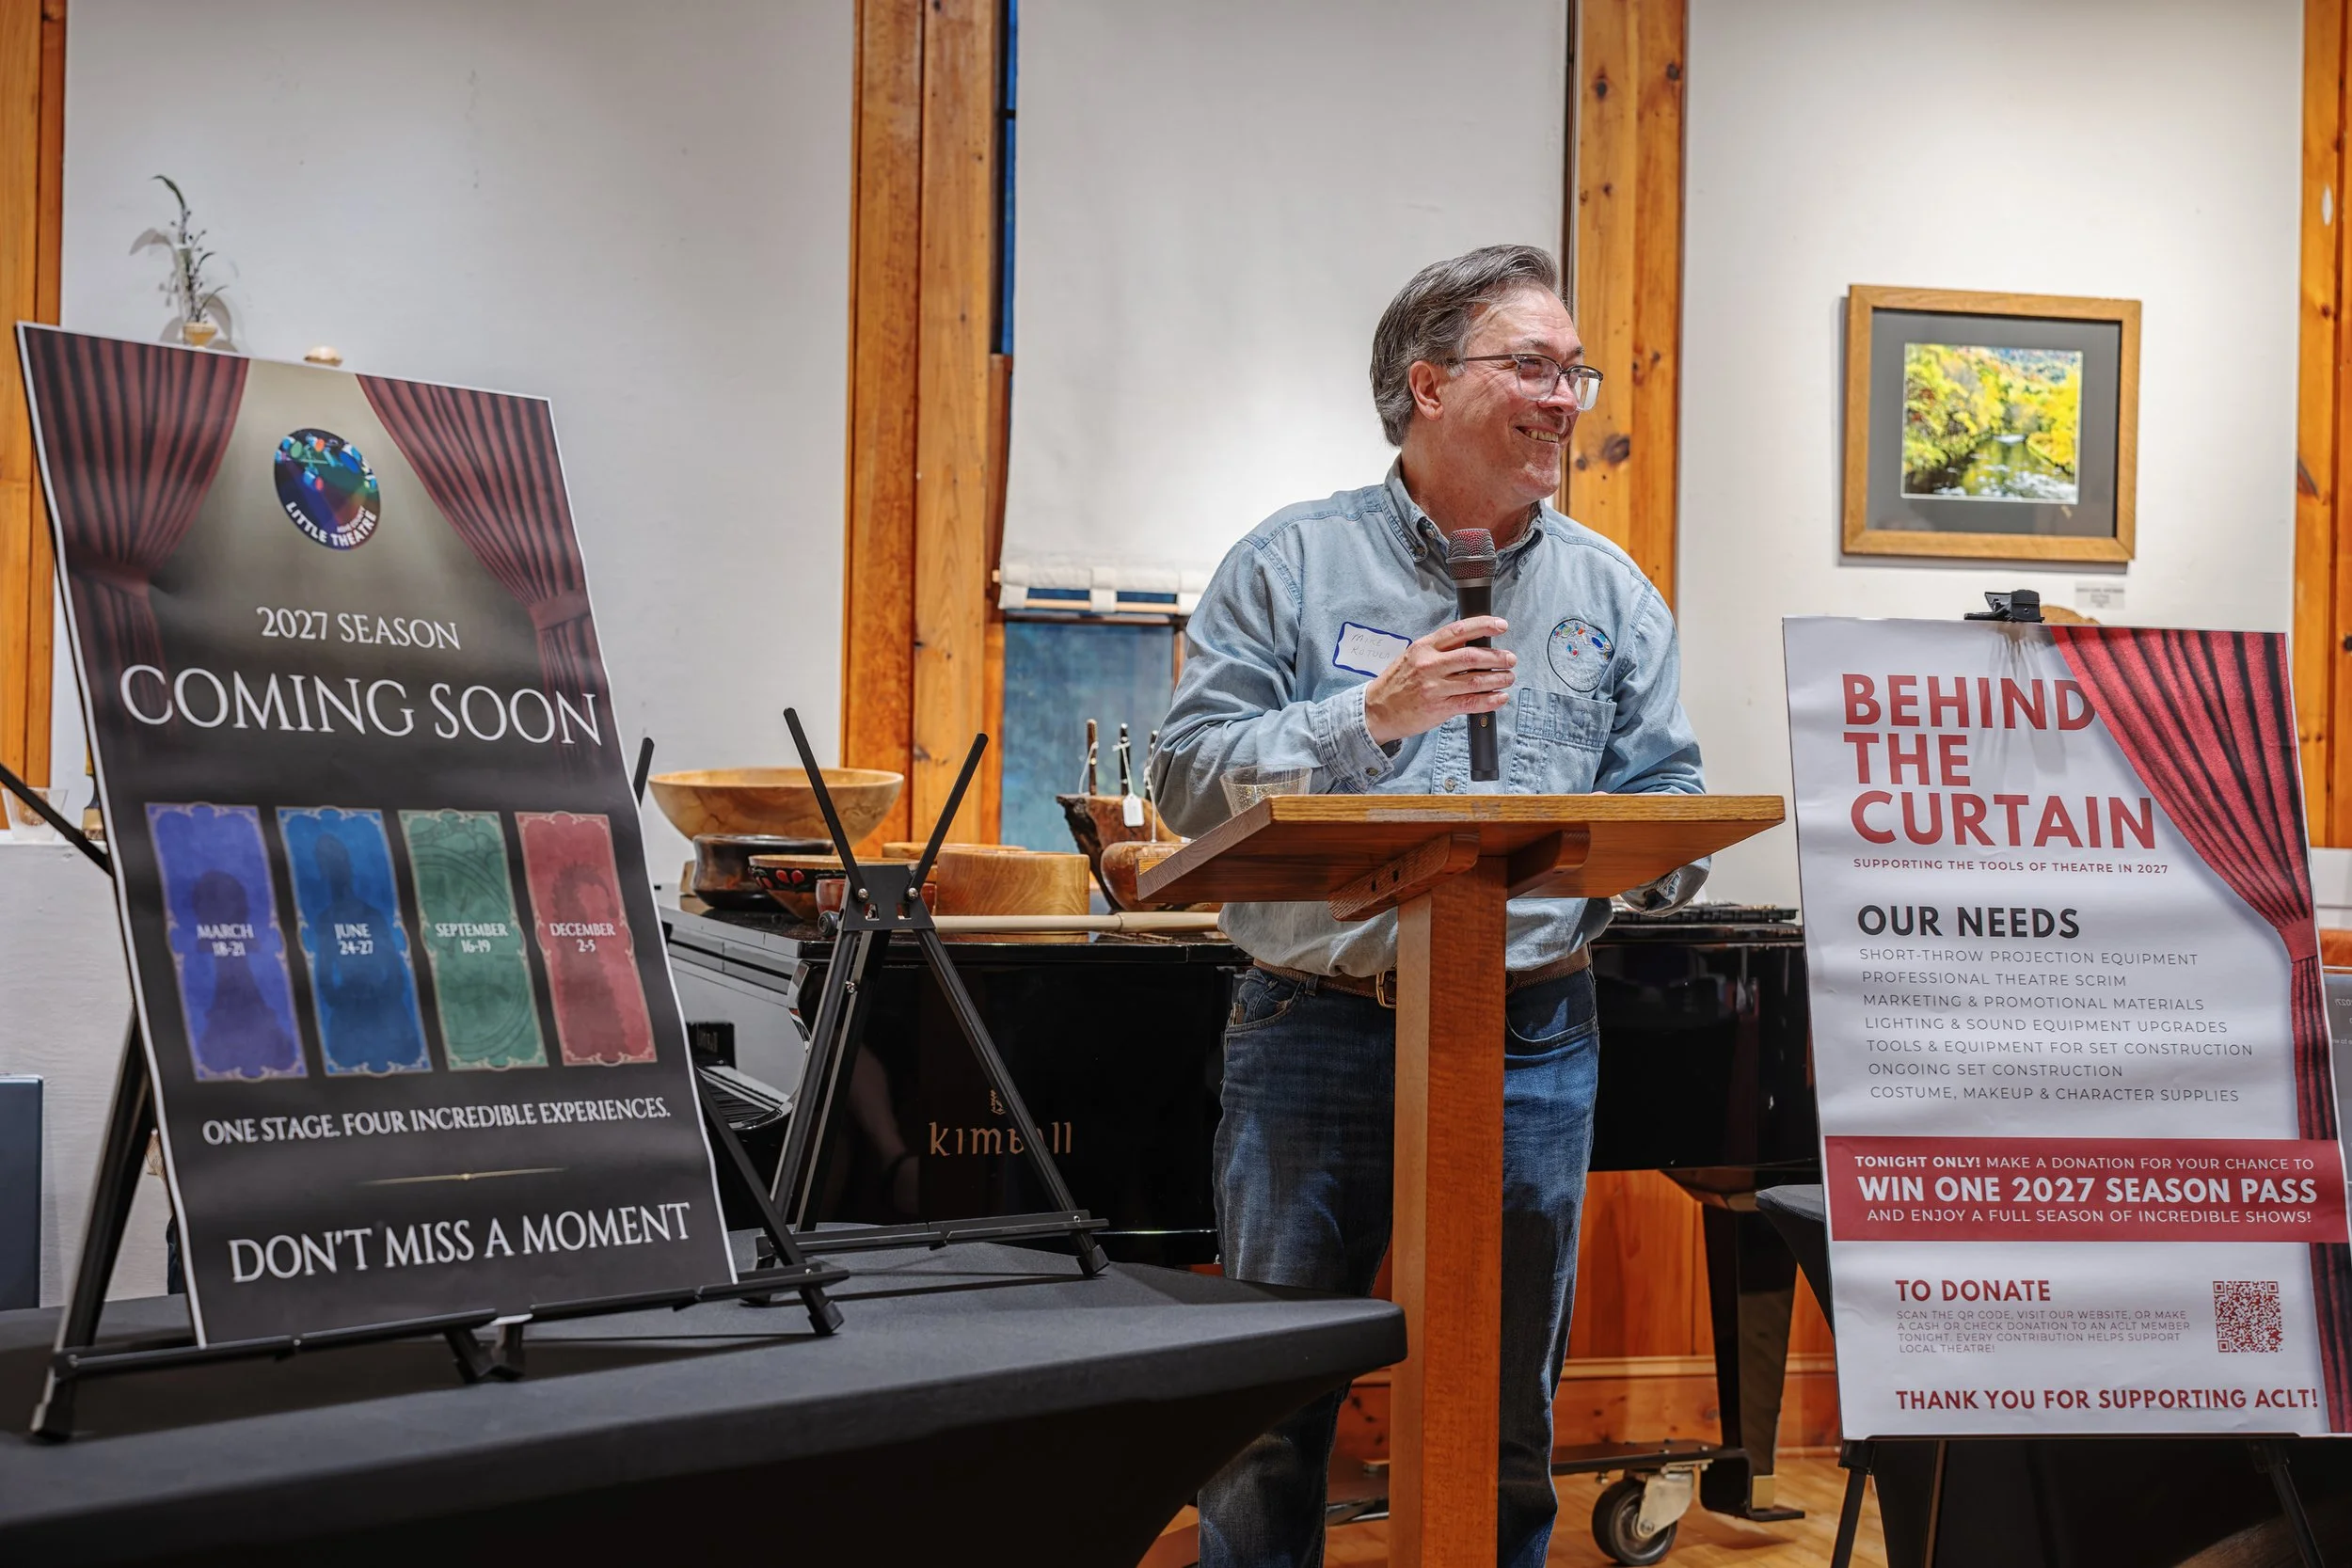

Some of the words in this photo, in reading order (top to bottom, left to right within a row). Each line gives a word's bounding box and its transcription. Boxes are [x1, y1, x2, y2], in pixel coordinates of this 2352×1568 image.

[286, 501, 327, 543] LITTLE
[330, 510, 376, 546] THEATRE
[256, 606, 328, 641] 2027
[337, 612, 461, 650] SEASON
[119, 664, 415, 736] COMING
[429, 683, 602, 746] SOON
[1842, 673, 2095, 730] BEHIND
[1844, 732, 1971, 787] THE
[1851, 791, 2156, 849] CURTAIN
[1853, 858, 1943, 870] SUPPORTING
[1947, 860, 1975, 870] THE
[1979, 861, 2025, 871] TOOLS
[2028, 862, 2047, 872] OF
[2051, 863, 2114, 873] THEATRE
[2118, 863, 2133, 873] IN
[2137, 863, 2169, 874] 2027
[435, 923, 508, 938] SEPTEMBER
[549, 923, 616, 937] DECEMBER
[1857, 904, 1943, 937] OUR
[1957, 906, 2080, 940] NEEDS
[196, 924, 255, 940] MARCH
[334, 923, 372, 940] JUNE
[338, 940, 373, 956] 24-27
[460, 940, 491, 953] 16-19
[576, 939, 596, 953] 2-5
[1859, 948, 1983, 962] SHORT-THROW
[1990, 950, 2094, 964] PROJECTION
[2101, 952, 2198, 966] EQUIPMENT
[1861, 971, 1990, 987] PROFESSIONAL
[1994, 973, 2069, 987] THEATRE
[2074, 974, 2126, 987] SCRIM
[1863, 993, 1962, 1007] MARKETING
[1967, 995, 1979, 1007] &
[1983, 995, 2107, 1009] PROMOTIONAL
[2113, 998, 2204, 1011] MATERIALS
[1865, 1017, 1945, 1030] LIGHTING
[1950, 1018, 1961, 1030] &
[1966, 1018, 2026, 1031] SOUND
[2032, 1019, 2131, 1033] EQUIPMENT
[2137, 1021, 2228, 1034] UPGRADES
[1866, 1039, 1922, 1053] TOOLS
[1928, 1040, 1938, 1053] &
[1944, 1040, 2043, 1054] EQUIPMENT
[2050, 1041, 2083, 1054] FOR
[2089, 1042, 2118, 1054] SET
[2123, 1042, 2253, 1056] CONSTRUCTION
[1868, 1063, 1950, 1076] ONGOING
[1957, 1063, 1986, 1076] SET
[1992, 1064, 2122, 1077] CONSTRUCTION
[1870, 1085, 1957, 1101] COSTUME,
[1963, 1086, 2033, 1100] MAKEUP
[2040, 1087, 2050, 1100] &
[2055, 1087, 2154, 1101] CHARACTER
[2160, 1088, 2239, 1102] SUPPLIES
[202, 1118, 259, 1145] ONE
[342, 1110, 408, 1136] FOUR
[409, 1103, 538, 1132] INCREDIBLE
[538, 1096, 672, 1124] EXPERIENCES.
[929, 1121, 1073, 1156] kimbll
[1854, 1155, 1928, 1168] TONIGHT
[1932, 1156, 1980, 1168] ONLY!
[1986, 1156, 2030, 1168] MAKE
[2036, 1157, 2046, 1168] A
[2051, 1157, 2135, 1169] DONATION
[2140, 1157, 2171, 1169] FOR
[2176, 1158, 2220, 1170] YOUR
[2224, 1158, 2289, 1170] CHANCE
[2293, 1158, 2314, 1170] TO
[1856, 1176, 1924, 1202] WIN
[1934, 1176, 2001, 1202] ONE
[2011, 1177, 2095, 1202] 2027
[2106, 1177, 2231, 1204] SEASON
[2240, 1178, 2317, 1204] PASS
[1867, 1209, 1905, 1222] AND
[1911, 1209, 1965, 1222] ENJOY
[1971, 1210, 1984, 1222] A
[1989, 1209, 2031, 1222] FULL
[2036, 1210, 2104, 1223] SEASON
[2109, 1210, 2132, 1222] OF
[2138, 1210, 2240, 1223] INCREDIBLE
[2245, 1211, 2312, 1224] SHOWS!
[229, 1227, 373, 1283] DON'T
[385, 1219, 475, 1268] MISS
[484, 1217, 516, 1259] A
[522, 1201, 691, 1255] MOMENT
[1895, 1279, 1931, 1302] TO
[1941, 1279, 2051, 1302] DONATE
[1896, 1309, 1928, 1320] SCAN
[1931, 1309, 1954, 1320] THE
[1957, 1309, 1974, 1322] QR
[2016, 1310, 2045, 1320] VISIT
[2048, 1310, 2074, 1320] OUR
[2134, 1310, 2151, 1320] OR
[2154, 1310, 2186, 1320] MAKE
[1897, 1322, 1905, 1331] A
[1908, 1321, 1939, 1331] CASH
[1943, 1322, 1961, 1331] OR
[1963, 1321, 2003, 1331] CHECK
[2007, 1321, 2068, 1331] DONATION
[2071, 1321, 2087, 1331] TO
[2090, 1322, 2106, 1330] AN
[2109, 1321, 2137, 1331] ACLT
[2140, 1321, 2190, 1331] MEMBER
[1956, 1332, 1993, 1342] EVERY
[1995, 1332, 2084, 1342] CONTRIBUTION
[2087, 1332, 2124, 1342] HELPS
[2127, 1332, 2181, 1341] SUPPORT
[1899, 1344, 1937, 1354] LOCAL
[1939, 1343, 1995, 1354] THEATRE!
[1895, 1390, 1979, 1410] THANK
[1983, 1389, 2035, 1410] YOU
[2043, 1389, 2091, 1409] FOR
[2098, 1388, 2247, 1411] SUPPORTING
[2254, 1388, 2318, 1408] ACLT!
